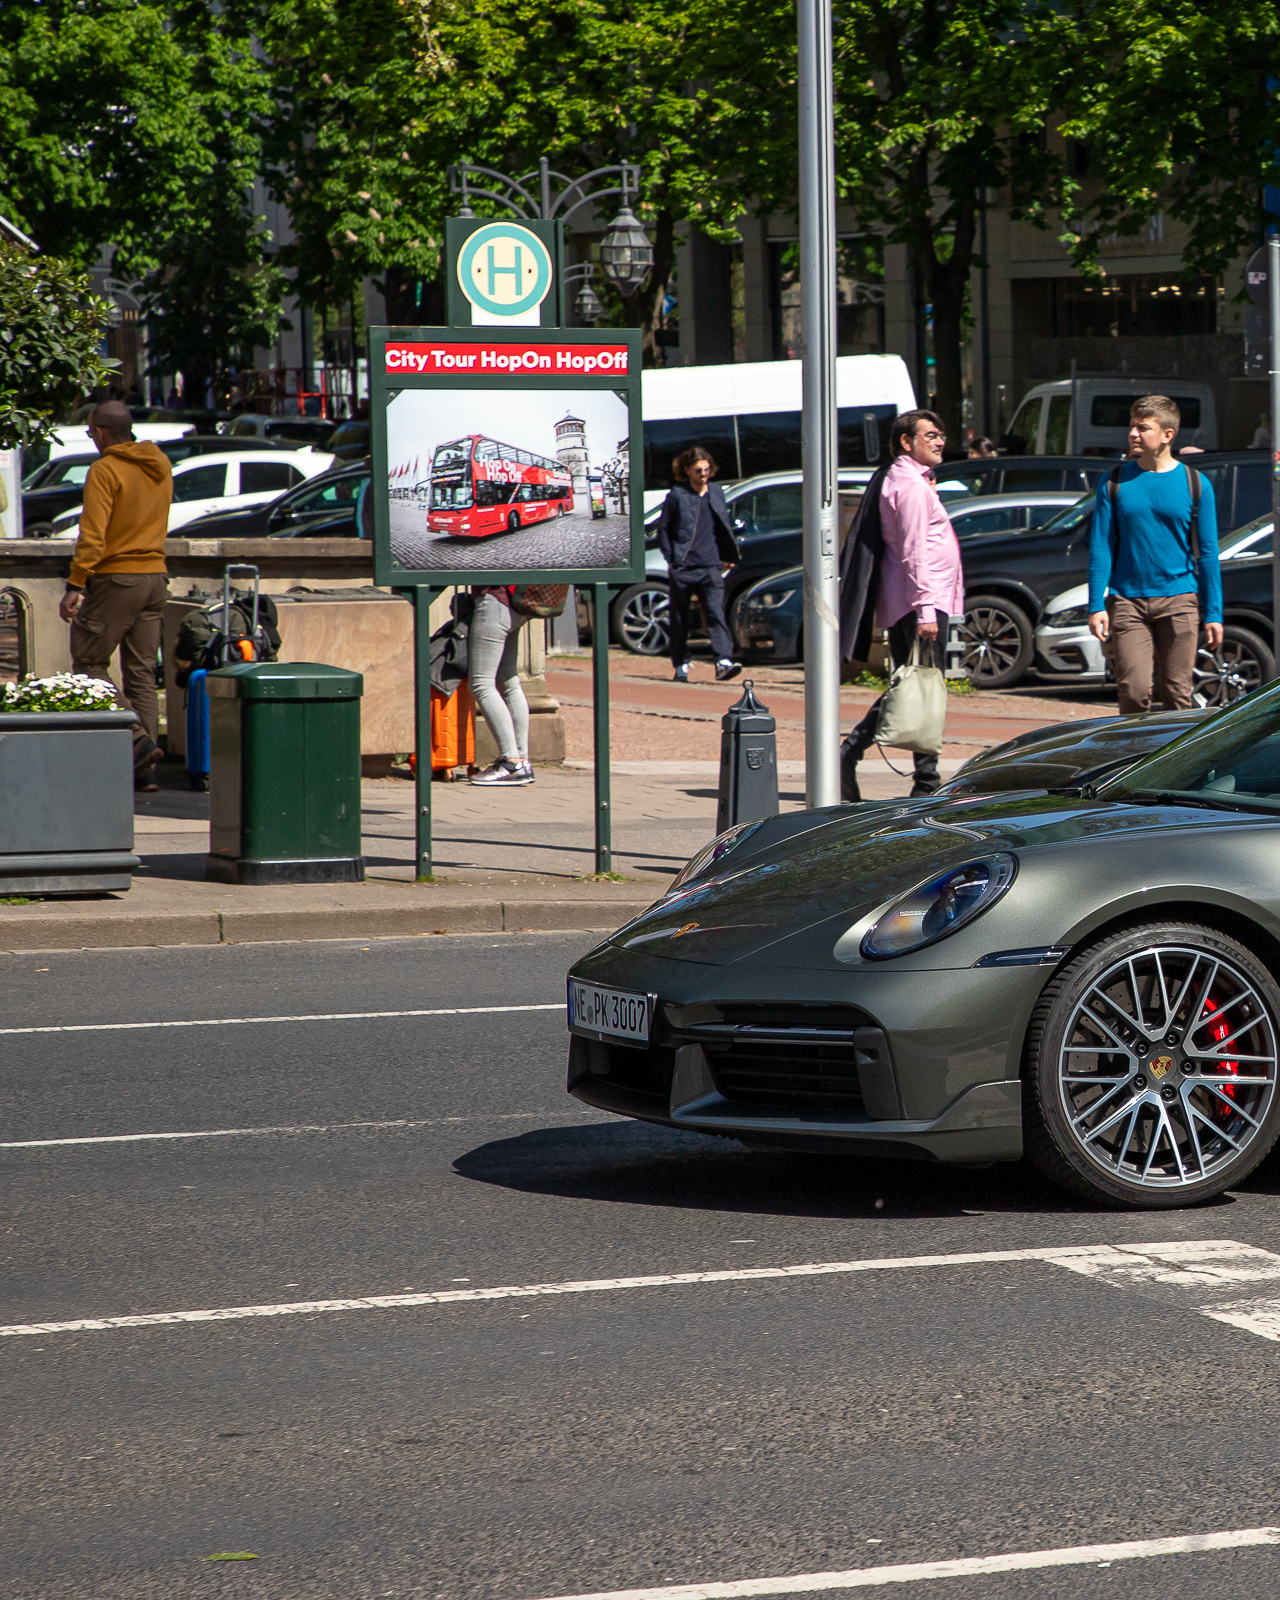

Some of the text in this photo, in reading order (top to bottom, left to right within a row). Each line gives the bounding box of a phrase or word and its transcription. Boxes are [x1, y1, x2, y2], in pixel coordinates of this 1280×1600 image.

[487, 245, 522, 296] H
[385, 349, 629, 373] City Tour HopOn HopOff
[479, 453, 503, 473] Hop
[486, 467, 509, 485] Hop
[574, 986, 646, 1033] NE PK 3007
